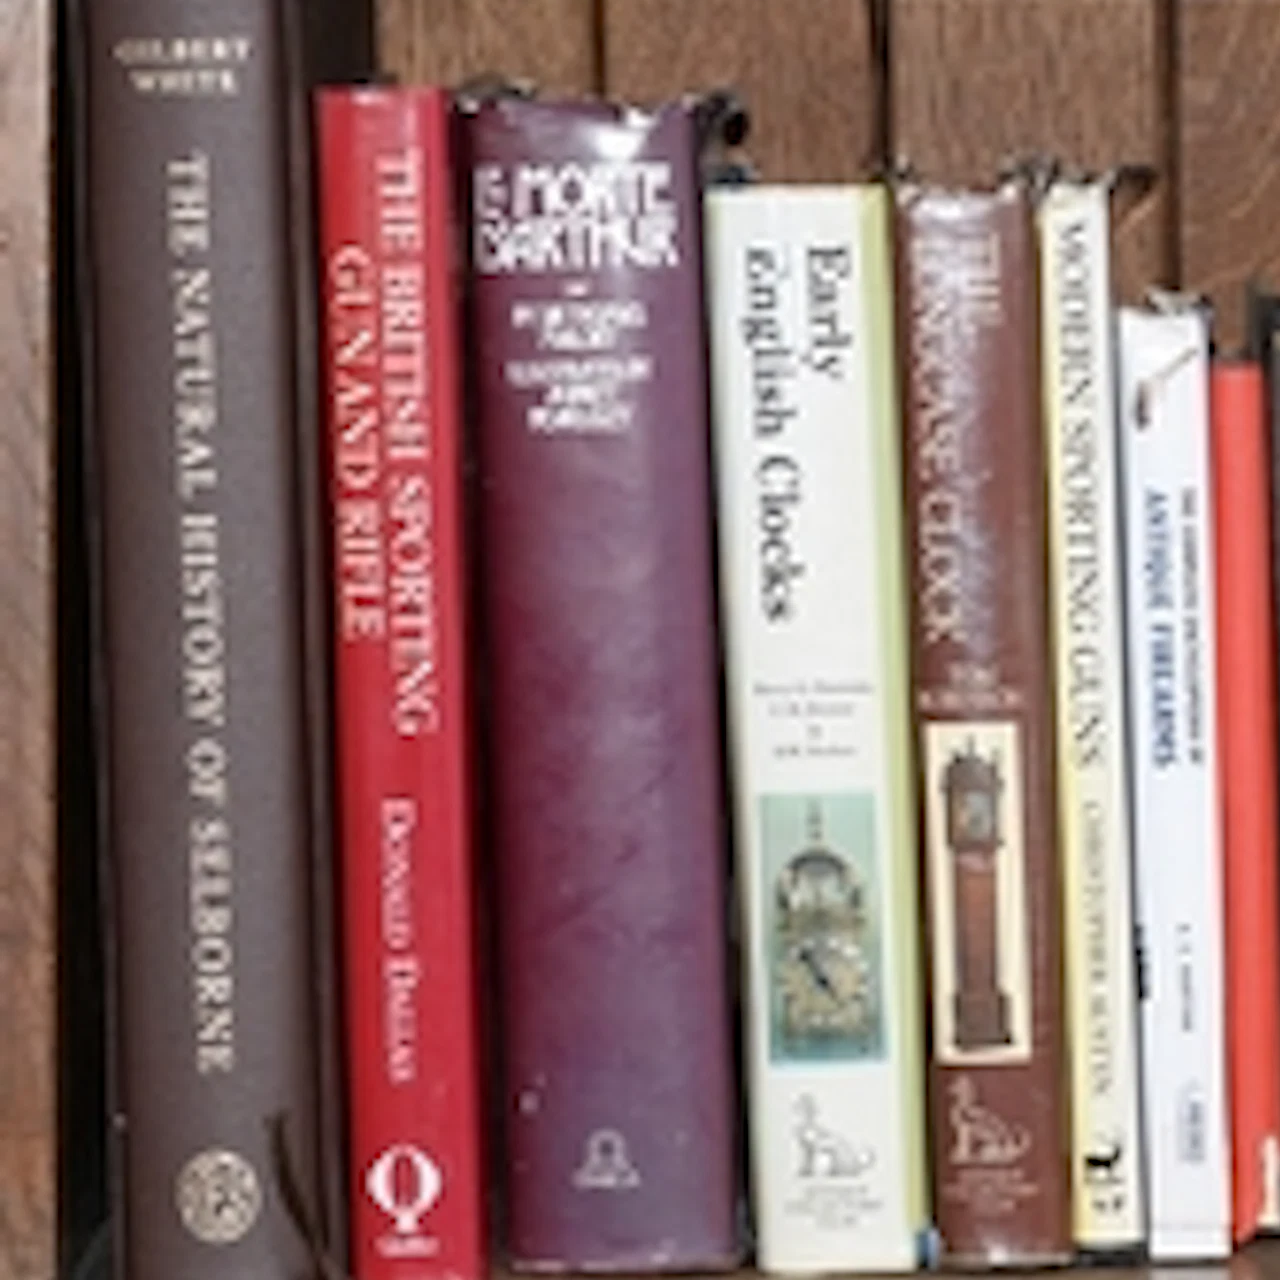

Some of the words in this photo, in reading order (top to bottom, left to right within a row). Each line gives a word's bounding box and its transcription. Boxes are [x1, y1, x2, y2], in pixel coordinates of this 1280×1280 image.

[113, 37, 252, 65] GILBERT
[130, 69, 238, 95] WHITE
[165, 150, 210, 256] THE
[376, 145, 424, 252] THE
[330, 243, 379, 367] GUN
[741, 246, 800, 439] English
[801, 244, 853, 382] Early
[962, 233, 1001, 327] THE
[1057, 221, 1096, 405] MODERN
[171, 267, 218, 499] NATURAL
[335, 372, 381, 489] AND
[381, 263, 429, 460] BRITISH
[338, 498, 387, 643] RIFLE
[755, 455, 804, 624] Clocks
[917, 492, 963, 644] CLOCK
[1062, 418, 1105, 632] SPORTING
[178, 512, 226, 725] HISTORY
[388, 472, 440, 737] SPORTING
[1069, 646, 1110, 769] GUNS
[1151, 622, 1179, 770] FIREARMS
[187, 737, 228, 808] OF
[188, 816, 235, 1074] SELBORNE
